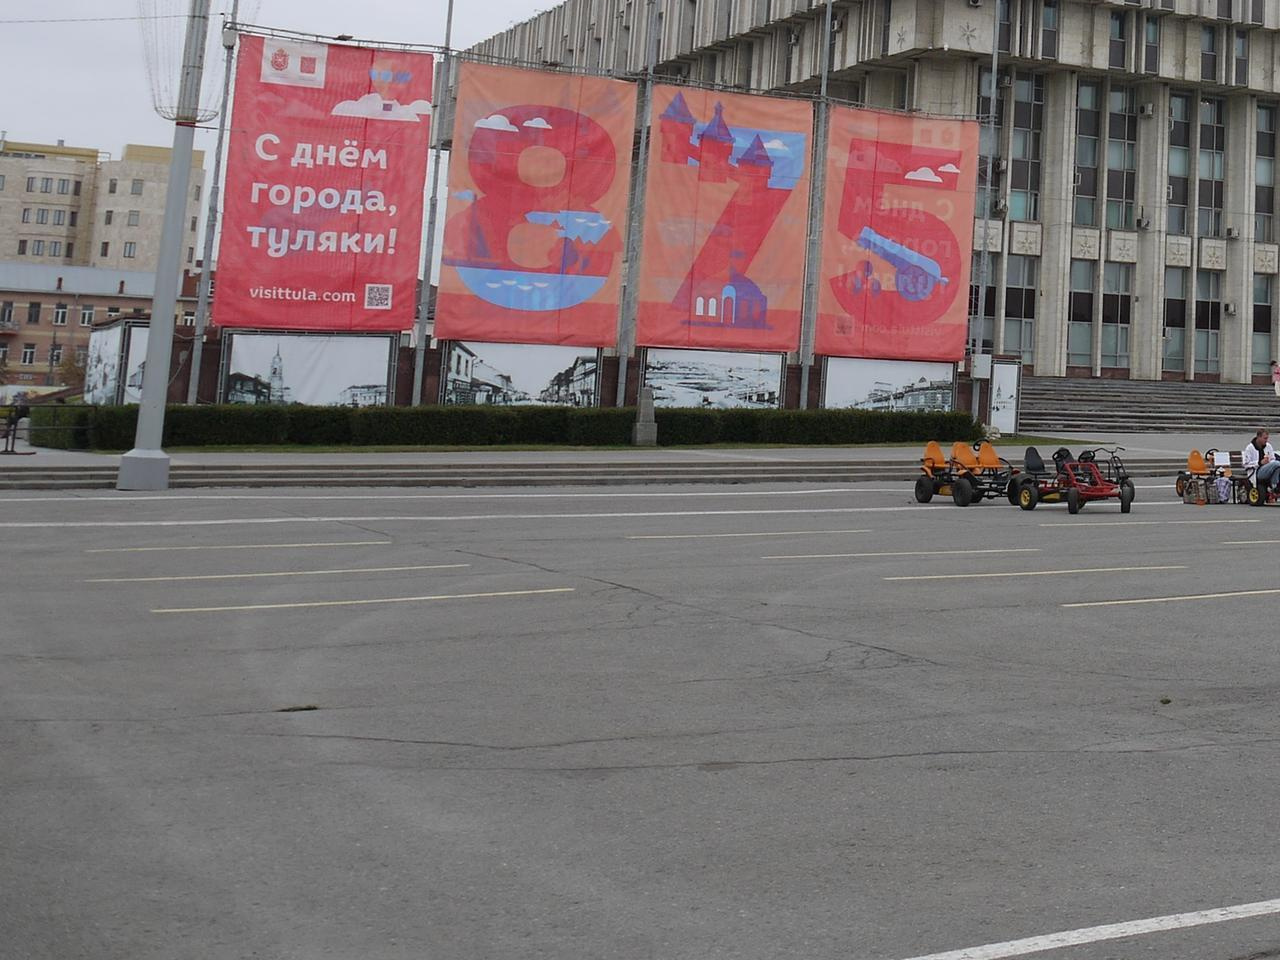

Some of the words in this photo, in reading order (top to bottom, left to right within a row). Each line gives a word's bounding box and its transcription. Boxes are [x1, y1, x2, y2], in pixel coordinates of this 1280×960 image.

[255, 133, 281, 161] С
[290, 139, 387, 169] днём
[250, 182, 397, 216] города,
[246, 226, 397, 258] туляки!
[249, 285, 357, 303] visittula.com
